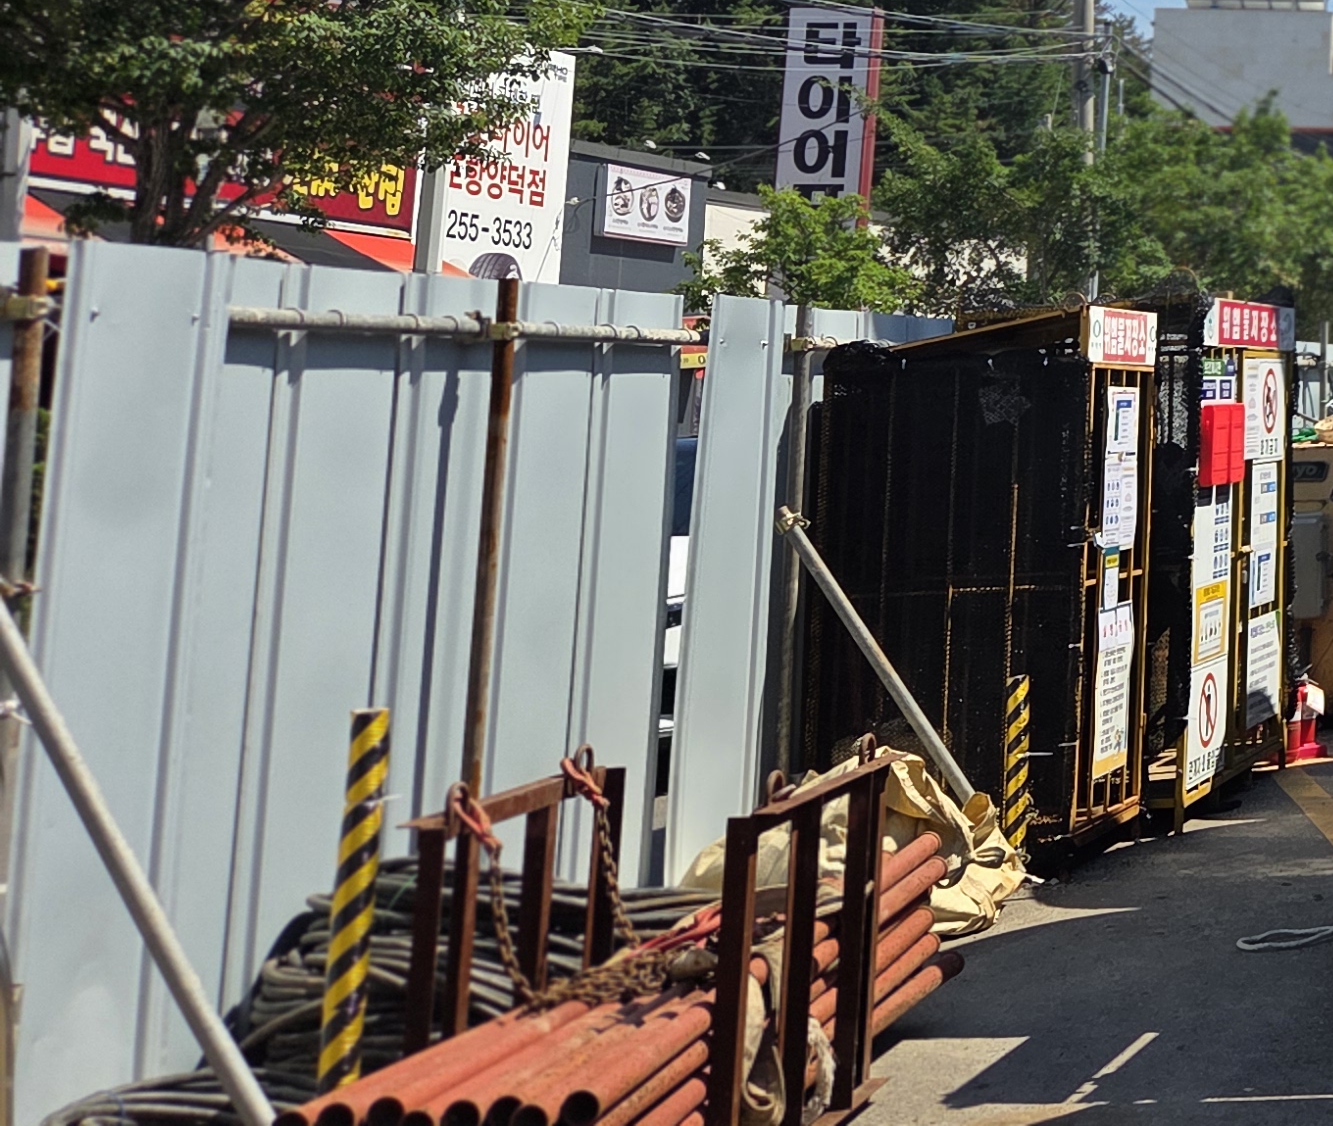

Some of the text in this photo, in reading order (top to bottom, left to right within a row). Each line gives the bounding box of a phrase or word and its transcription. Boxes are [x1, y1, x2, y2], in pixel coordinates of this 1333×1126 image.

[446, 209, 533, 250] 255-3533
[1104, 316, 1146, 357] 위험물저장소
[1222, 306, 1277, 343] 위험물저장소
